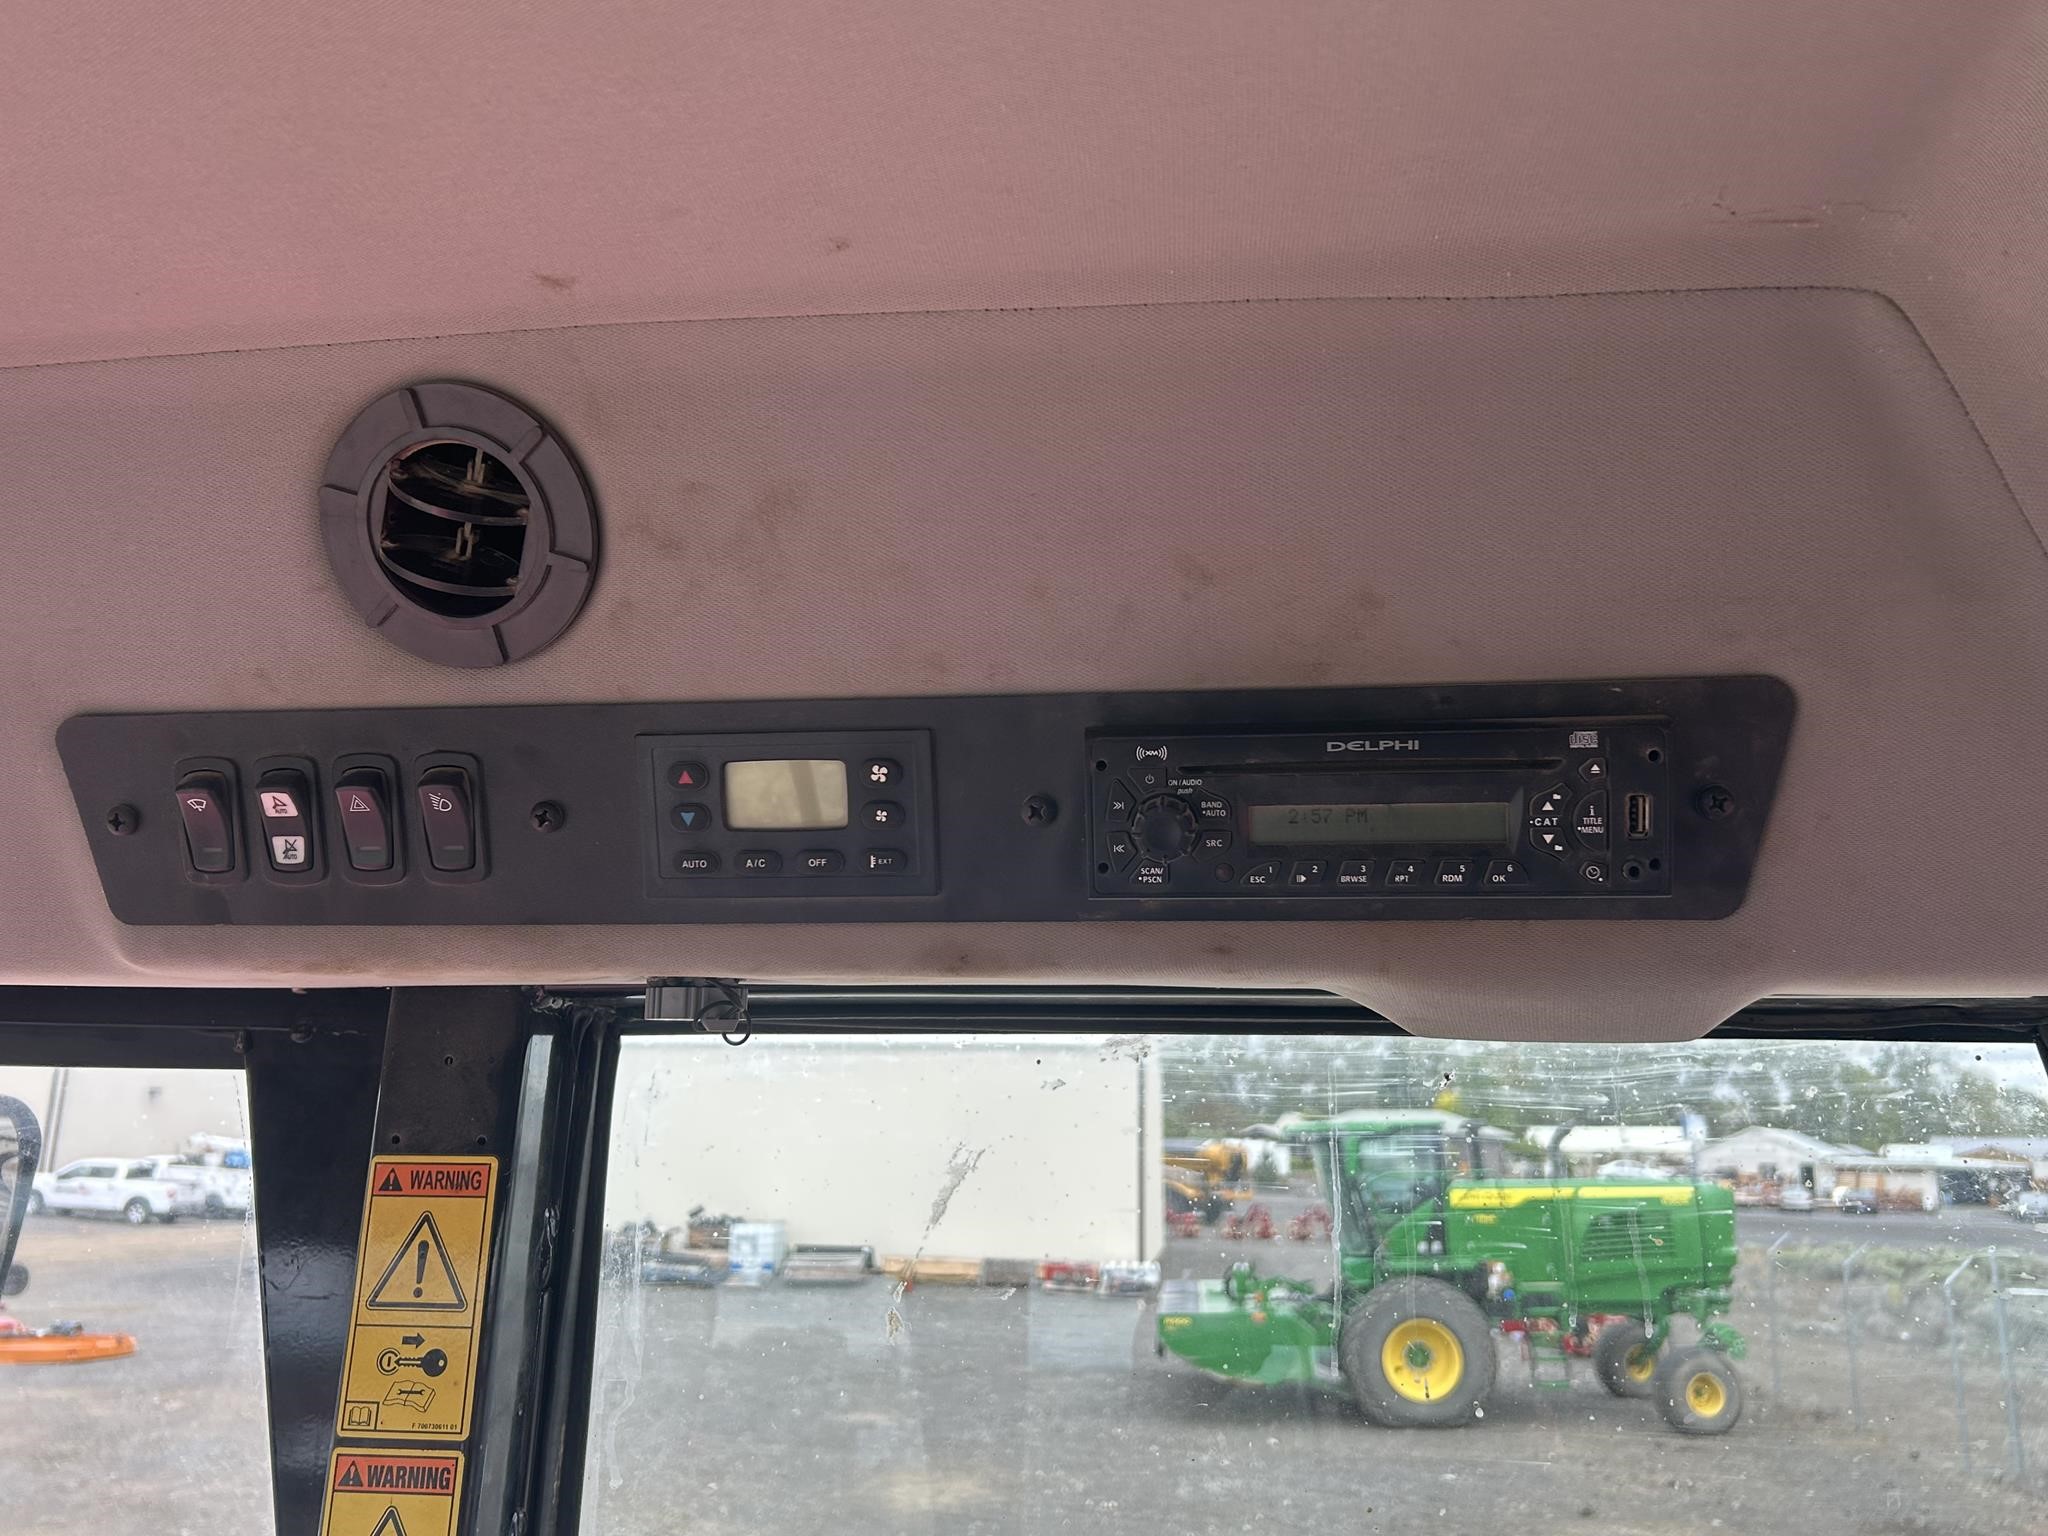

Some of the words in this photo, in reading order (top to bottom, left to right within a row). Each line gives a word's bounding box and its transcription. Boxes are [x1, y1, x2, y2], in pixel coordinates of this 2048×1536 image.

[1326, 740, 1419, 752] DELPHI
[1177, 787, 1193, 795] push
[1288, 808, 1333, 824] 2:57
[1345, 807, 1369, 824] PM
[1583, 817, 1603, 825] TITLE
[1206, 839, 1223, 847] SRC
[682, 859, 707, 868] AUTO
[745, 858, 766, 868] A/C
[808, 858, 828, 867] OFF
[1312, 865, 1318, 873] 2
[1360, 865, 1366, 873] 3
[1460, 864, 1466, 873] 5
[1507, 864, 1513, 872] 6
[1340, 875, 1367, 883] BRWSE
[1442, 874, 1463, 882] RDM
[1492, 874, 1506, 882] OK
[409, 1169, 482, 1191] WARNING
[367, 1464, 452, 1490] WARNING
